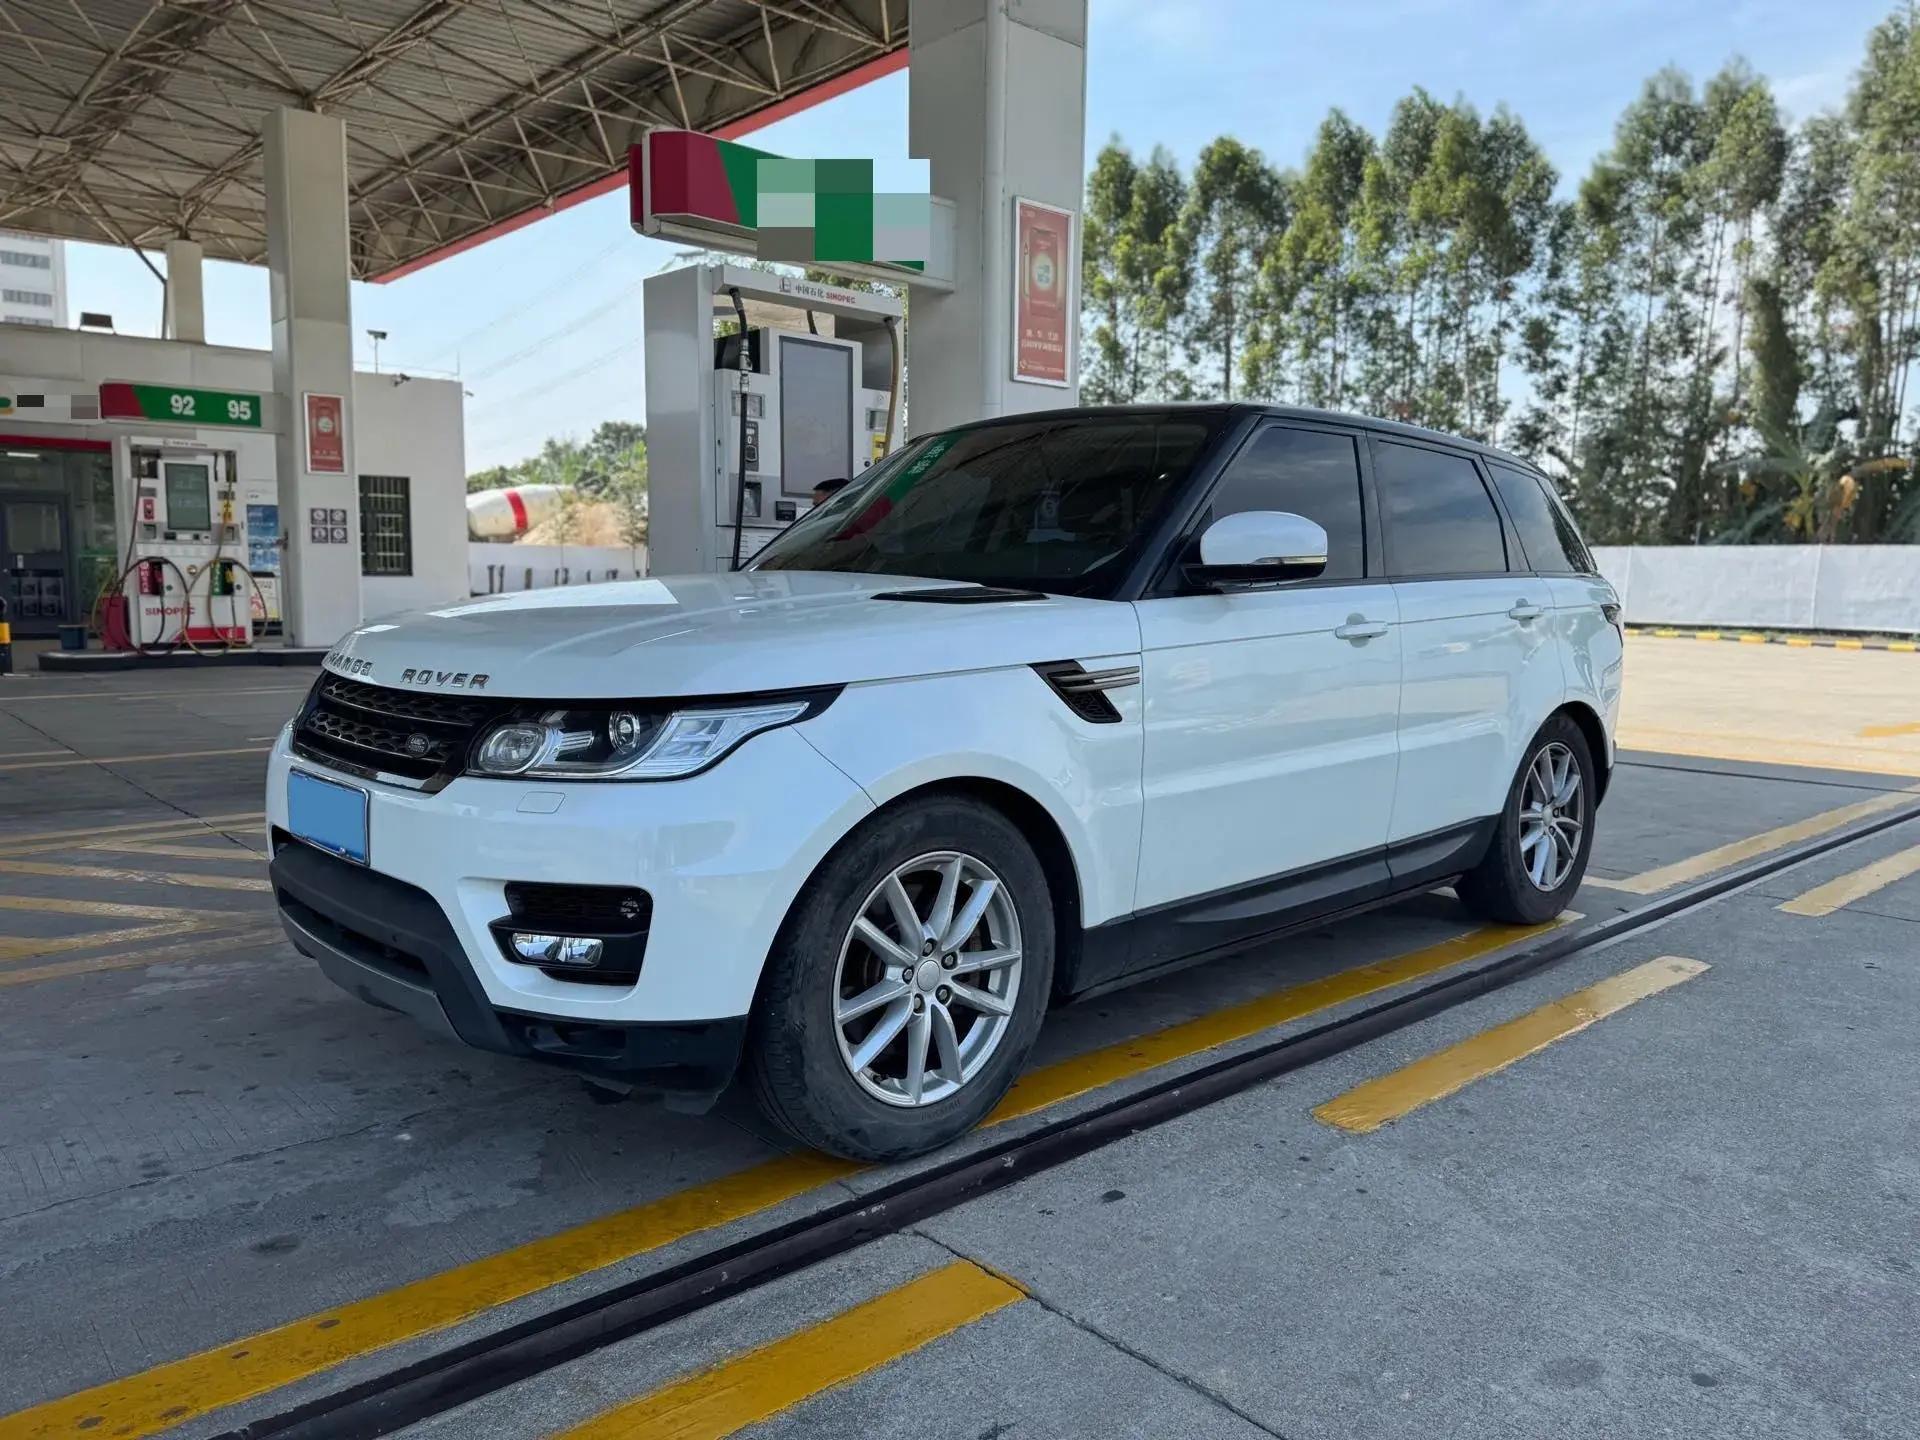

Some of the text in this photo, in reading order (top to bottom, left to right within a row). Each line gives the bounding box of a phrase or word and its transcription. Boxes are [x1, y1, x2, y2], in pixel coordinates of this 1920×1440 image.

[795, 284, 825, 298] 中国石化
[170, 394, 252, 420] 92 95
[144, 606, 196, 616] SINOPC
[401, 668, 490, 689] ROVER
